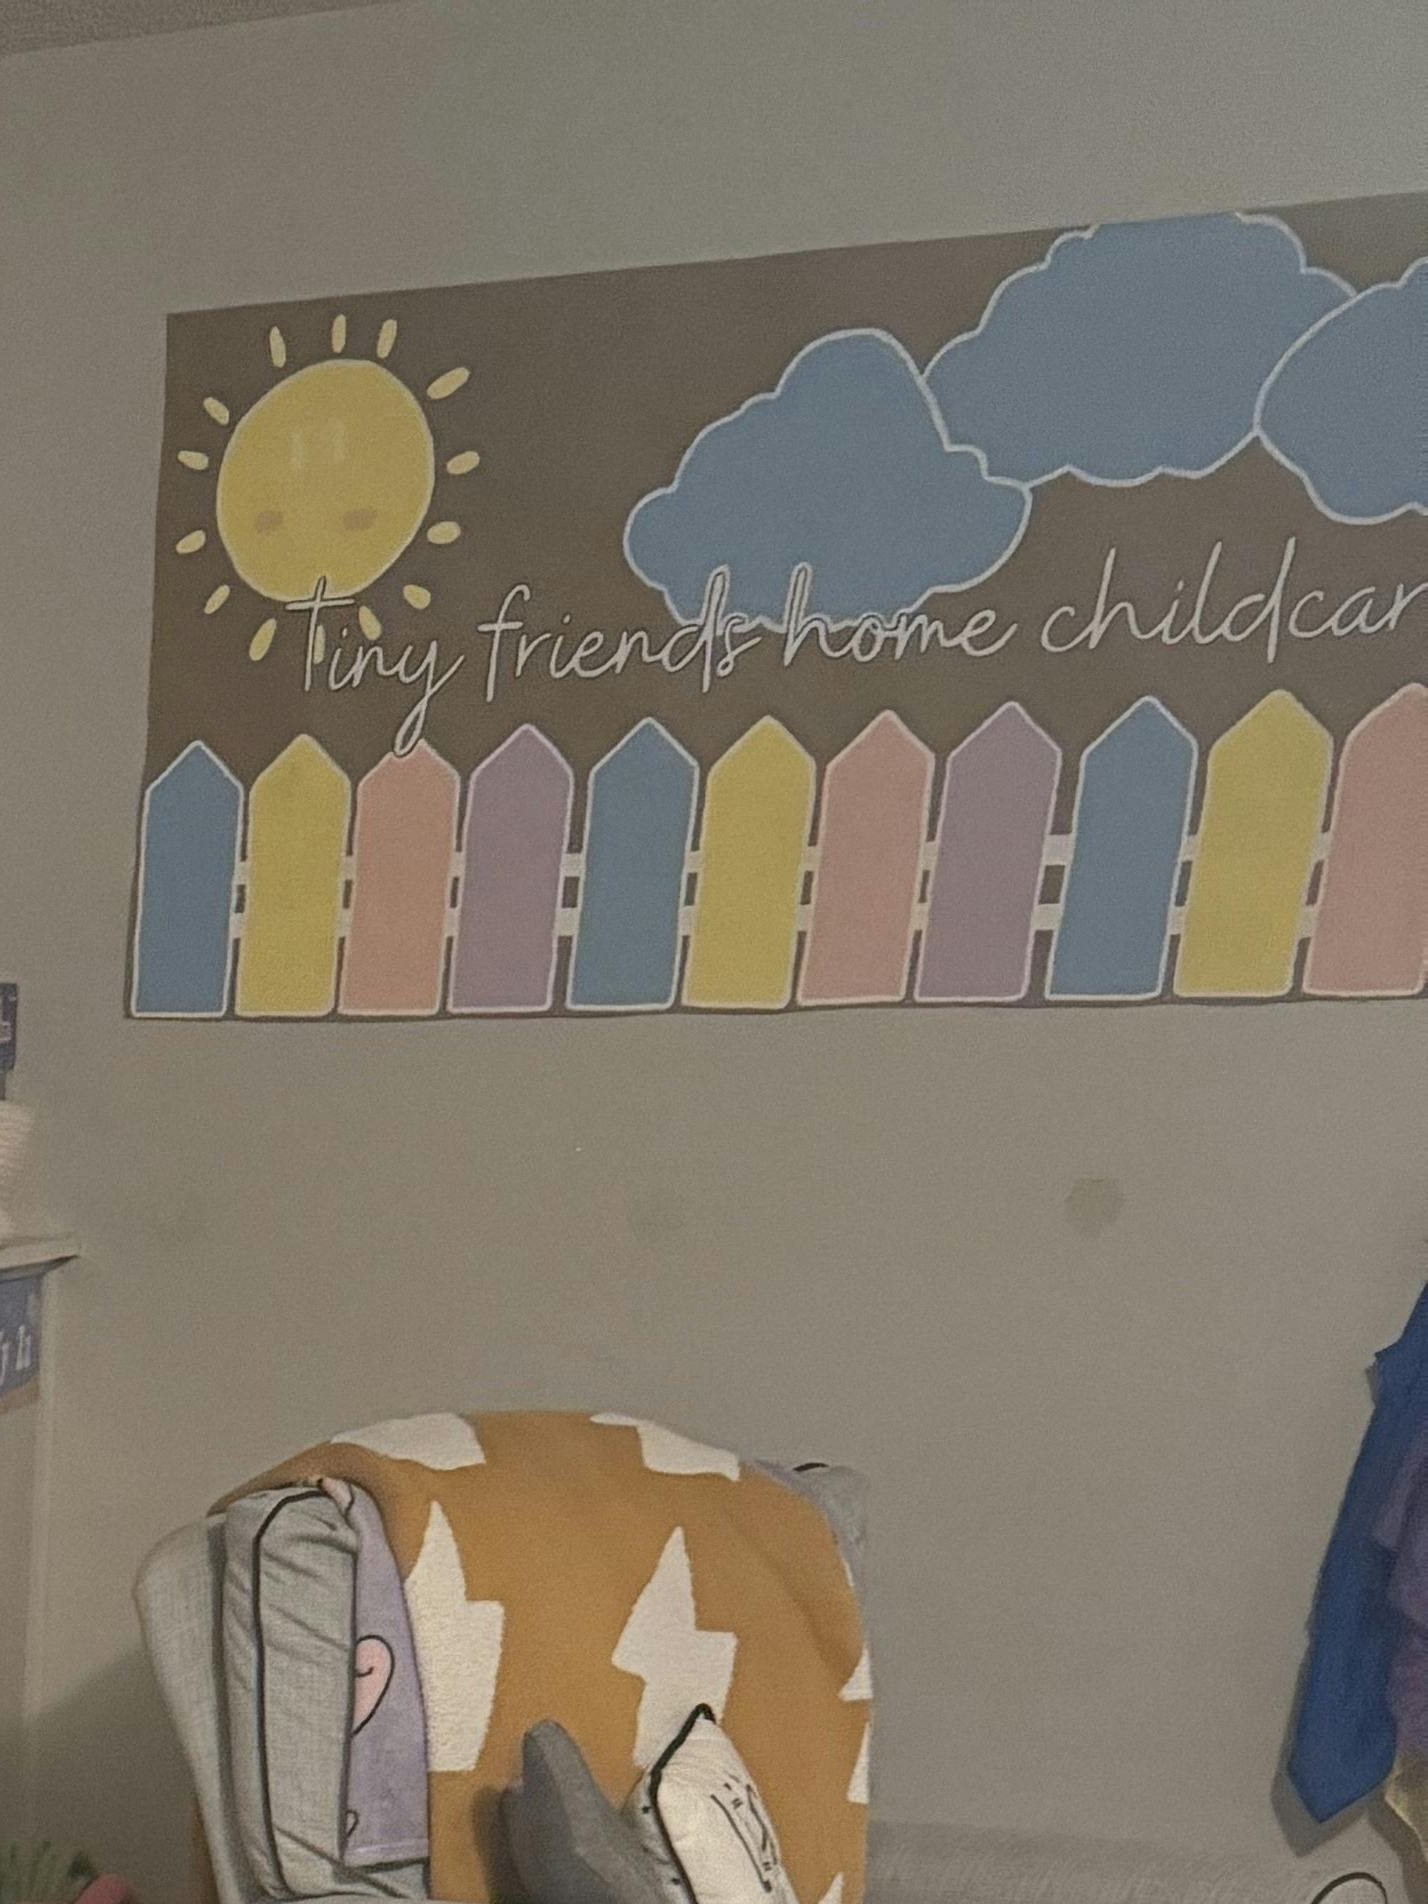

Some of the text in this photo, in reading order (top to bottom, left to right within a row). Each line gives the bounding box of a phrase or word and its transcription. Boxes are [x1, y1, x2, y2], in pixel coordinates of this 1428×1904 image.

[284, 575, 464, 758] Tiny
[477, 563, 761, 702] friends
[781, 561, 1019, 667] home
